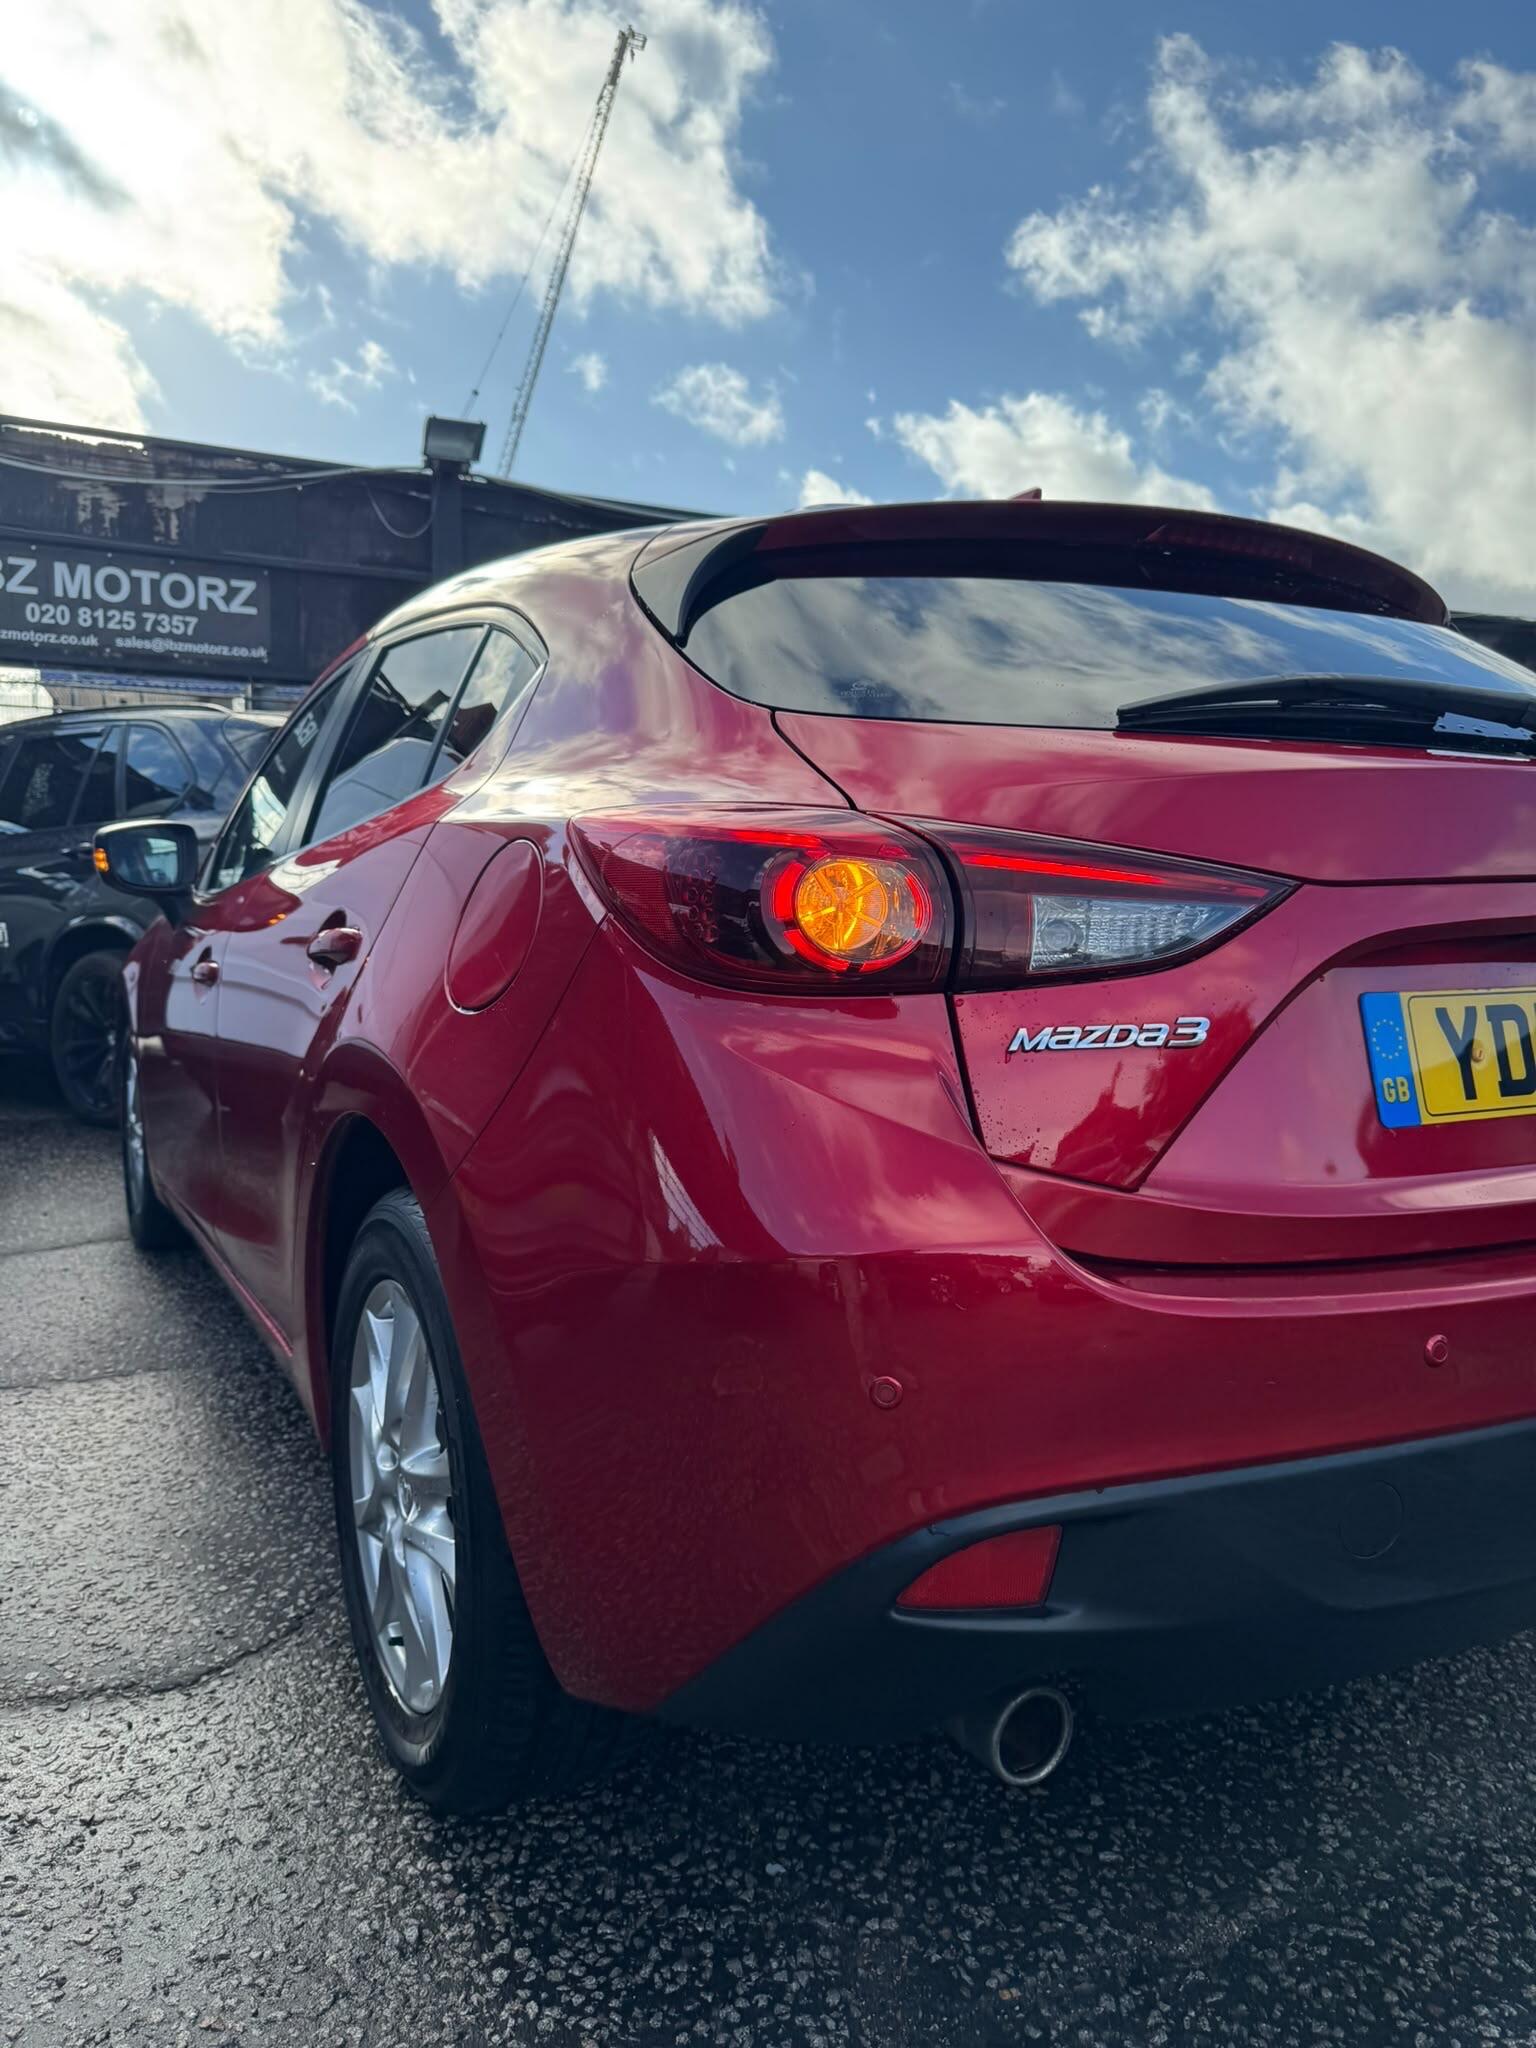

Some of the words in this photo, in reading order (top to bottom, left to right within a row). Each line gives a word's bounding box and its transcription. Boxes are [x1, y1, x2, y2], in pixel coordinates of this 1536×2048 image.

[0, 556, 39, 595] Z
[54, 561, 258, 615] MOTORZ
[25, 602, 71, 626] 020
[77, 606, 136, 631] 8125
[141, 612, 199, 636] 7357
[0, 629, 99, 647] zmotorz.co.uk
[115, 636, 268, 658] sales@ibzmotorz.co.uk
[1435, 1003, 1536, 1101] YD
[1382, 1076, 1411, 1104] GB
